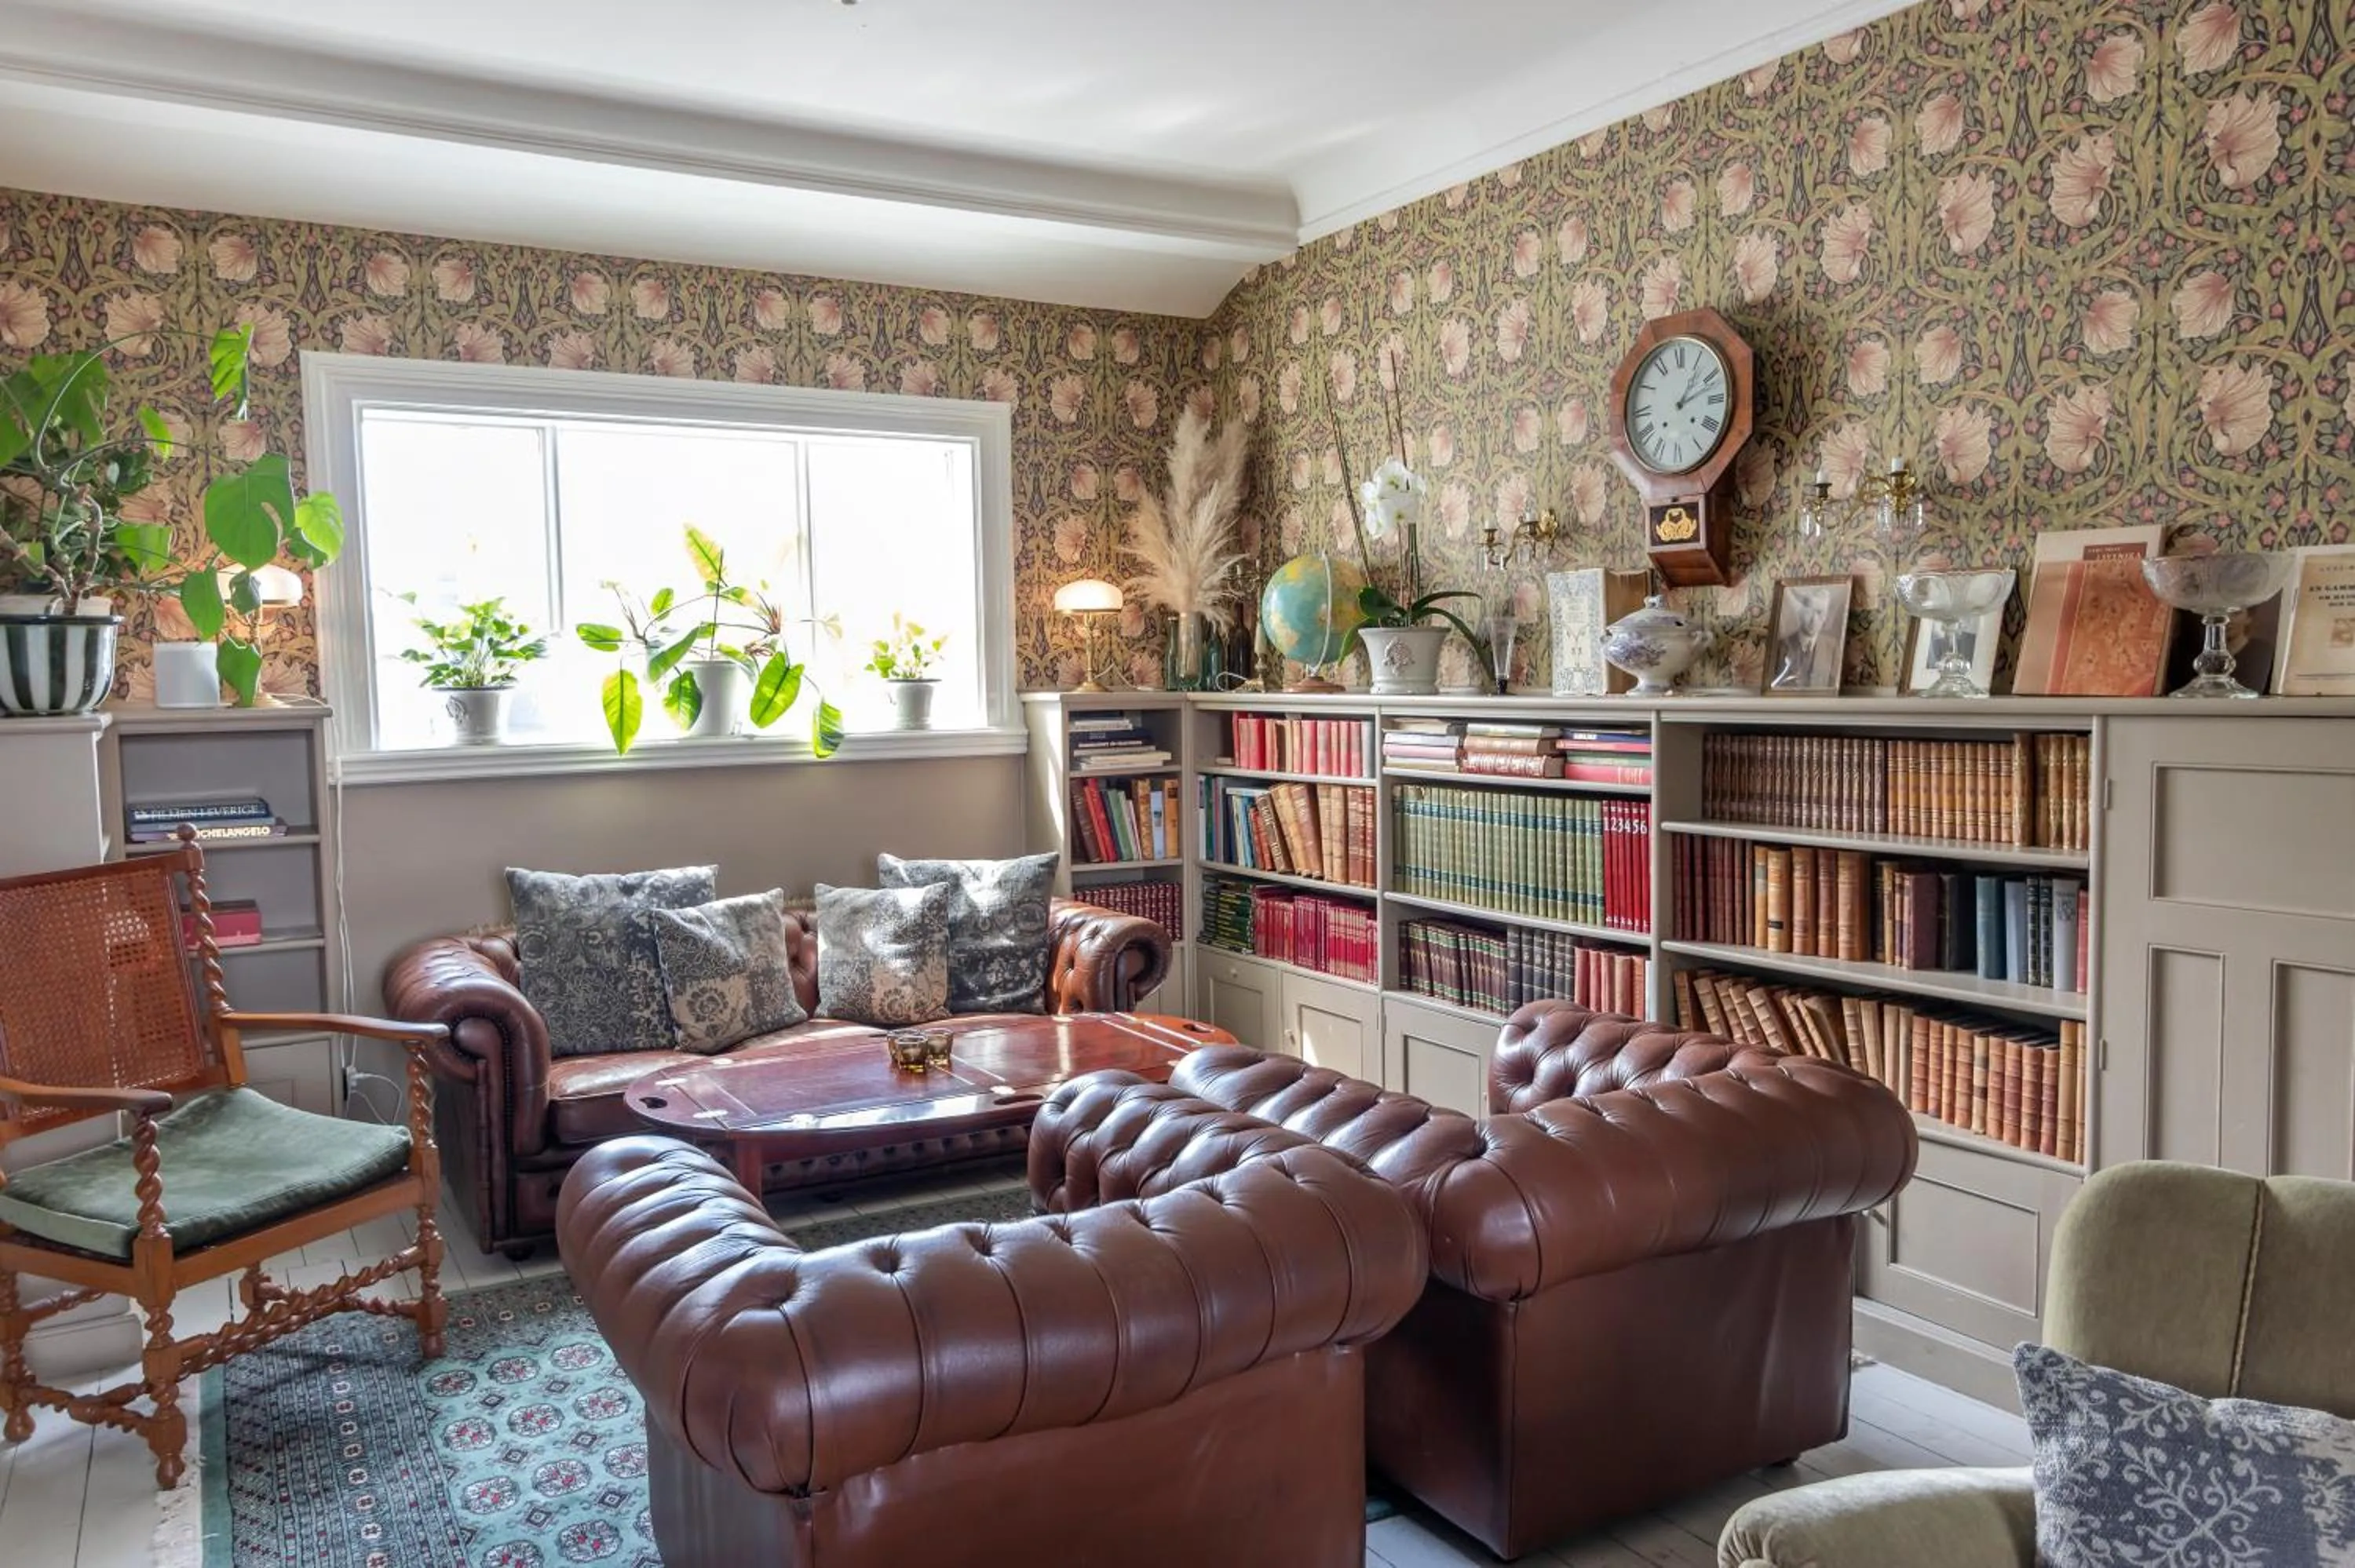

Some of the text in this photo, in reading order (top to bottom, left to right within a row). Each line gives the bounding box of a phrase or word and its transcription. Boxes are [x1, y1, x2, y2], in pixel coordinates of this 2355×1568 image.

[1604, 816, 1610, 832] 1
[1610, 815, 1618, 832] 2
[1617, 817, 1624, 833] 3
[1624, 818, 1631, 833] 4
[1632, 819, 1640, 835] 5
[1640, 819, 1648, 835] 6
[195, 826, 271, 840] ICHELANGELO
